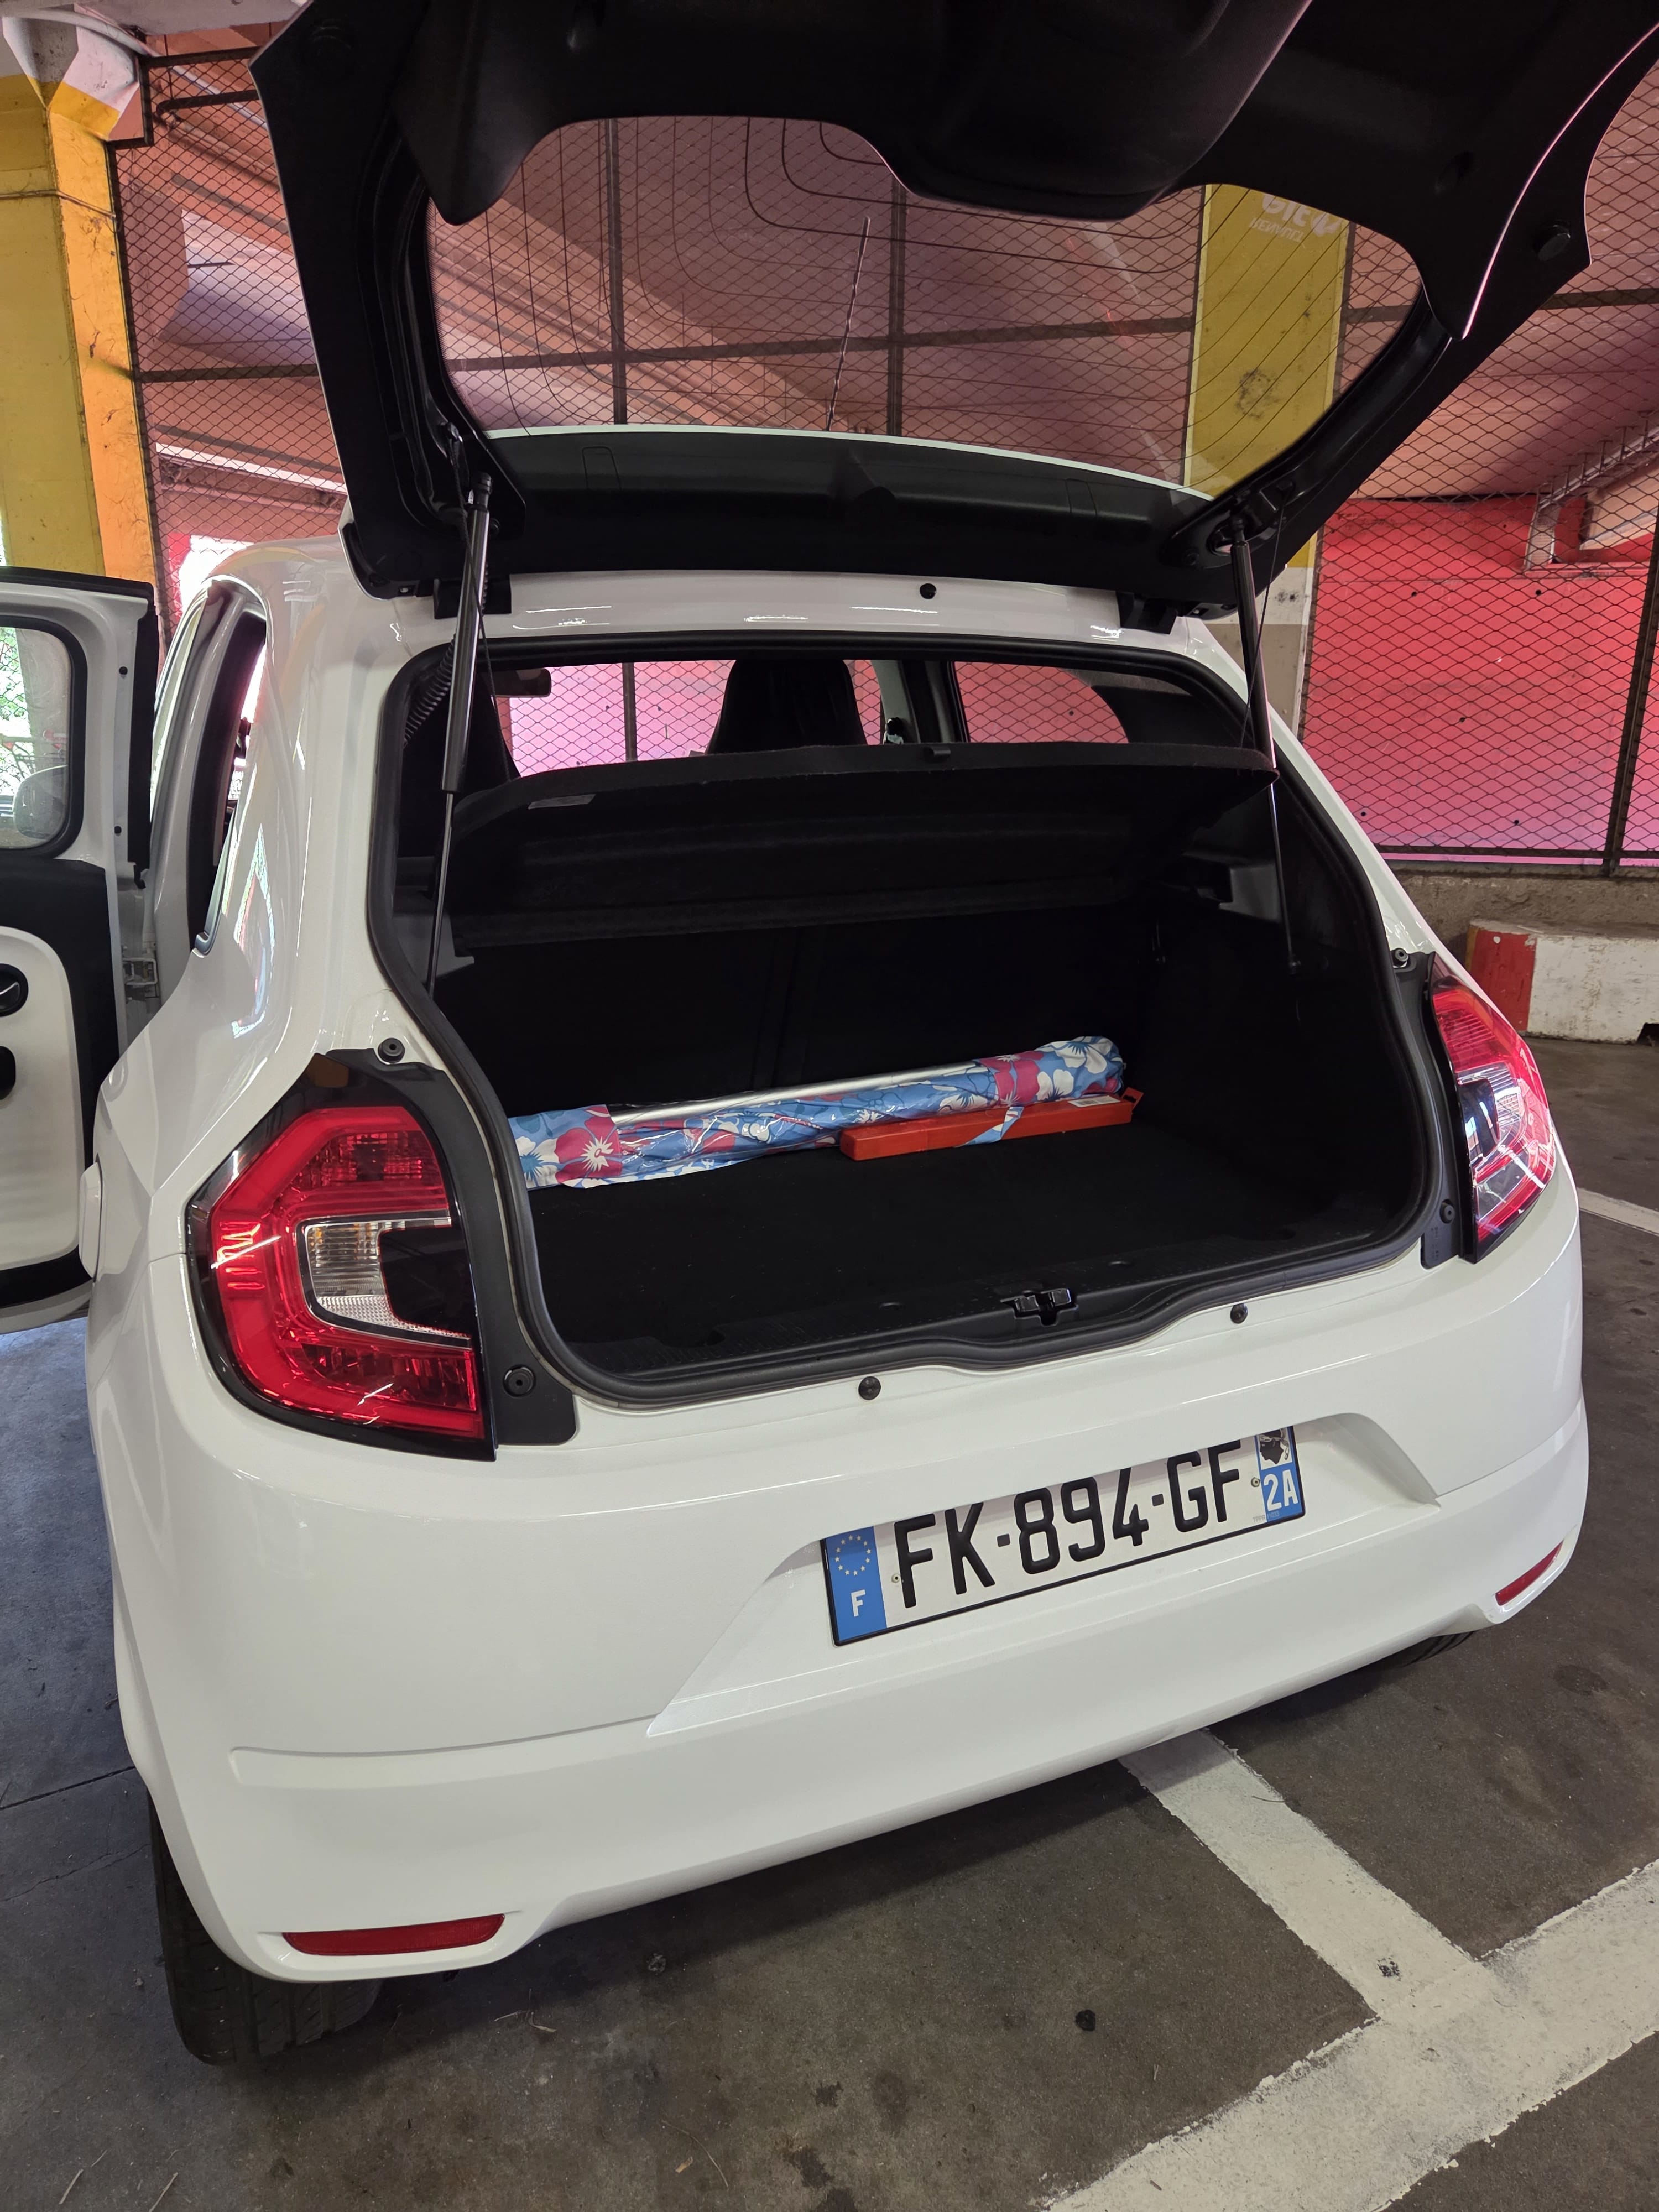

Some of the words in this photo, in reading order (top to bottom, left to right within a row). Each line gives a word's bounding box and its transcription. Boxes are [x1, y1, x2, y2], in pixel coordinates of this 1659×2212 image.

[1264, 1469, 1298, 1510] 2A
[894, 1441, 1241, 1609] FK-894-GF
[851, 1589, 866, 1617] F
